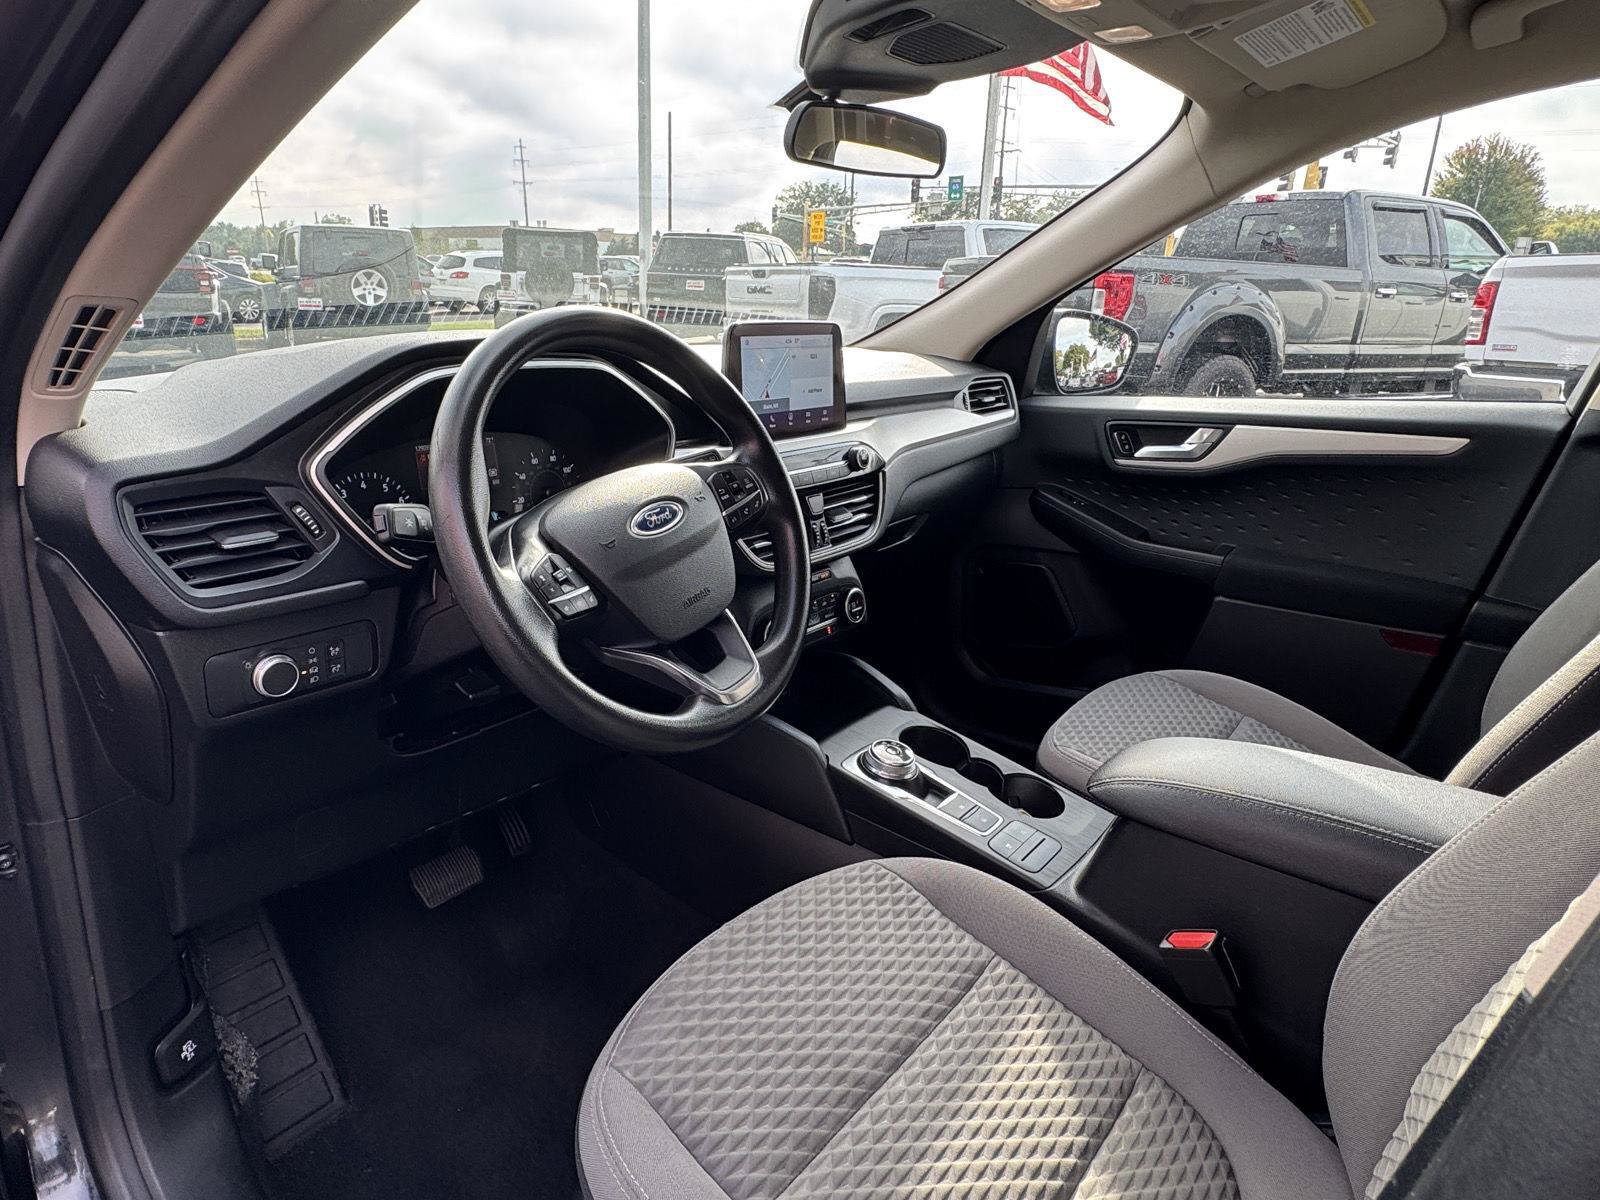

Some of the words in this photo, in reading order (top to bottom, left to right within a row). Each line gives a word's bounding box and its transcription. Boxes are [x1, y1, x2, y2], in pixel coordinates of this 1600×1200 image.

[746, 285, 773, 295] GMC
[562, 466, 572, 474] 100
[360, 481, 367, 490] 4
[382, 483, 389, 492] 5
[340, 489, 347, 499] 3
[644, 506, 672, 528] Ford
